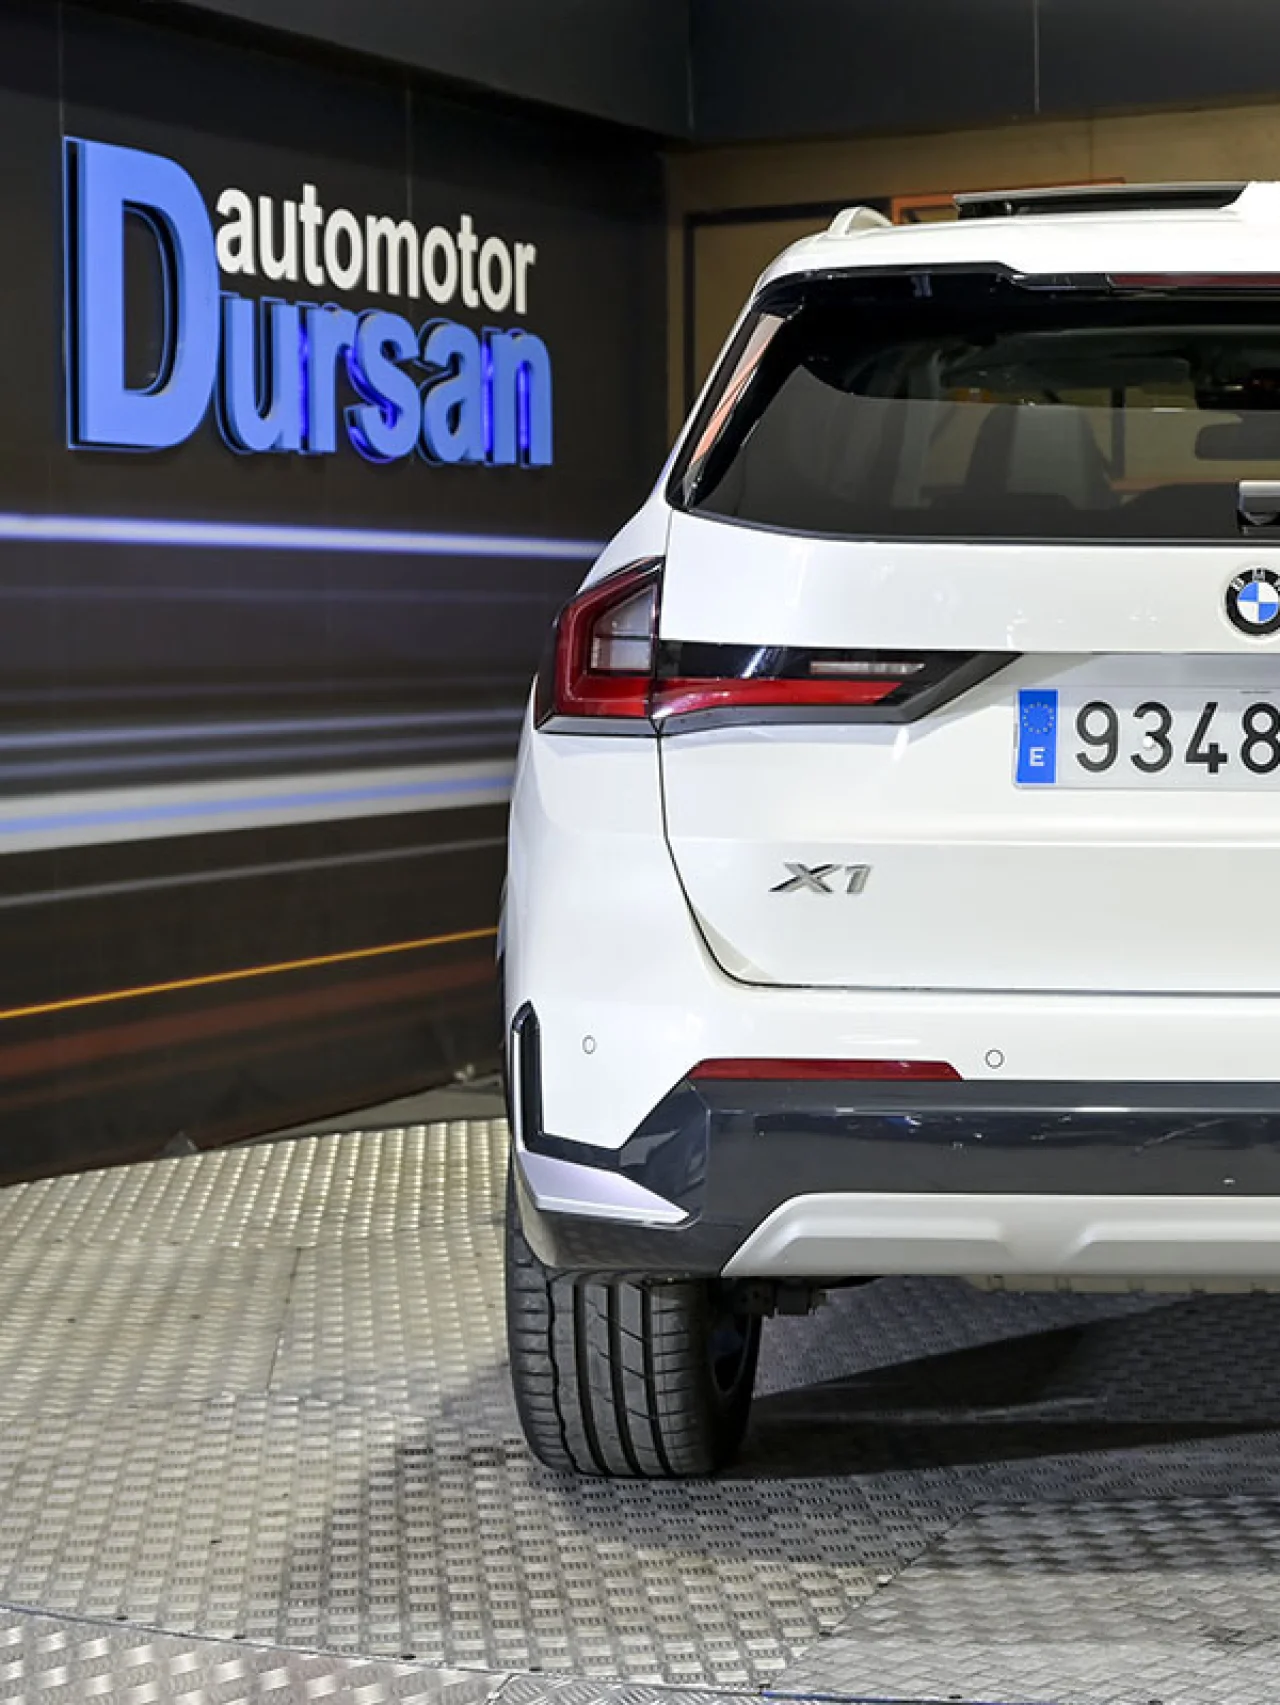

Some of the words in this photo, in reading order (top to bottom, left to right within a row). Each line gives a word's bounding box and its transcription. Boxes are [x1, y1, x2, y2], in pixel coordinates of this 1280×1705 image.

[215, 183, 536, 314] automotor
[64, 136, 553, 466] Dursan
[1030, 748, 1046, 768] E
[768, 863, 872, 894] X1
